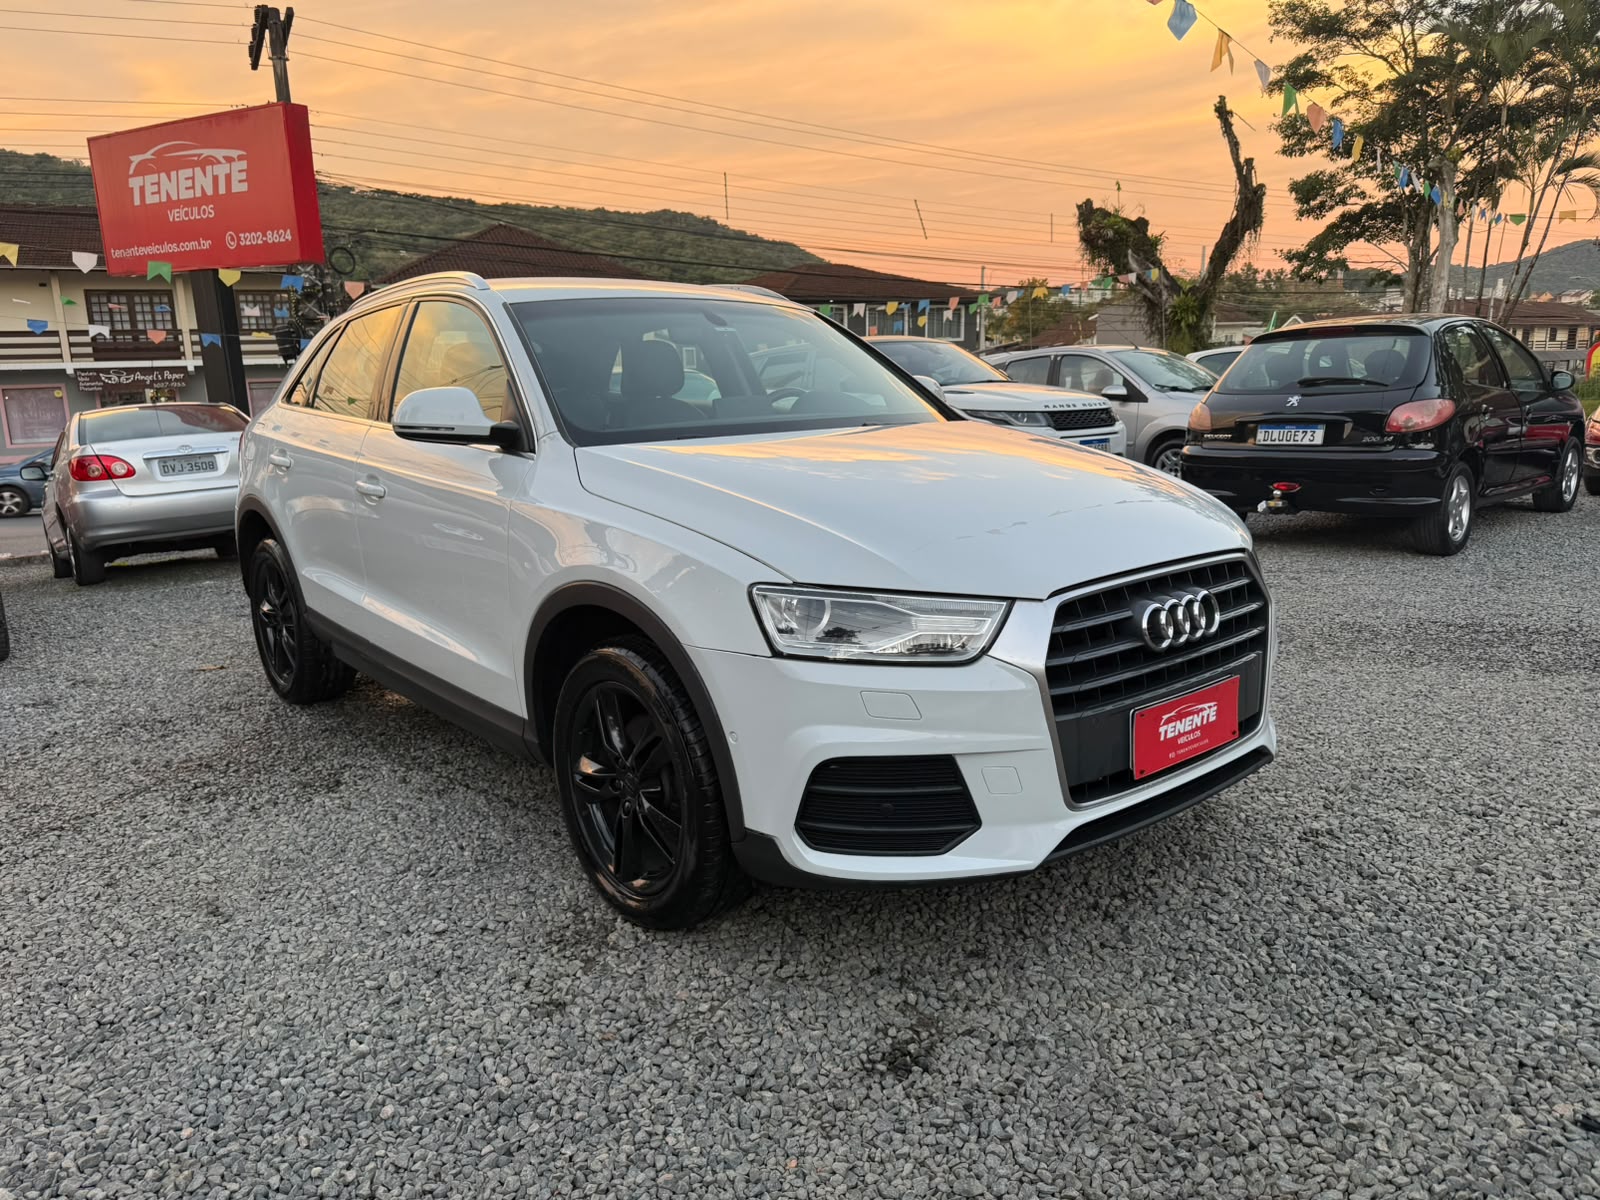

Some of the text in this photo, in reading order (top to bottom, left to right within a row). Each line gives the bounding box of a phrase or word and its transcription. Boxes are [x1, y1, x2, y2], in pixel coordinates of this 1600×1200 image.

[129, 160, 248, 206] TENENTE
[168, 204, 215, 222] VEÍCULOS
[239, 229, 292, 246] 3202-8624
[1159, 705, 1218, 742] TENENTE
